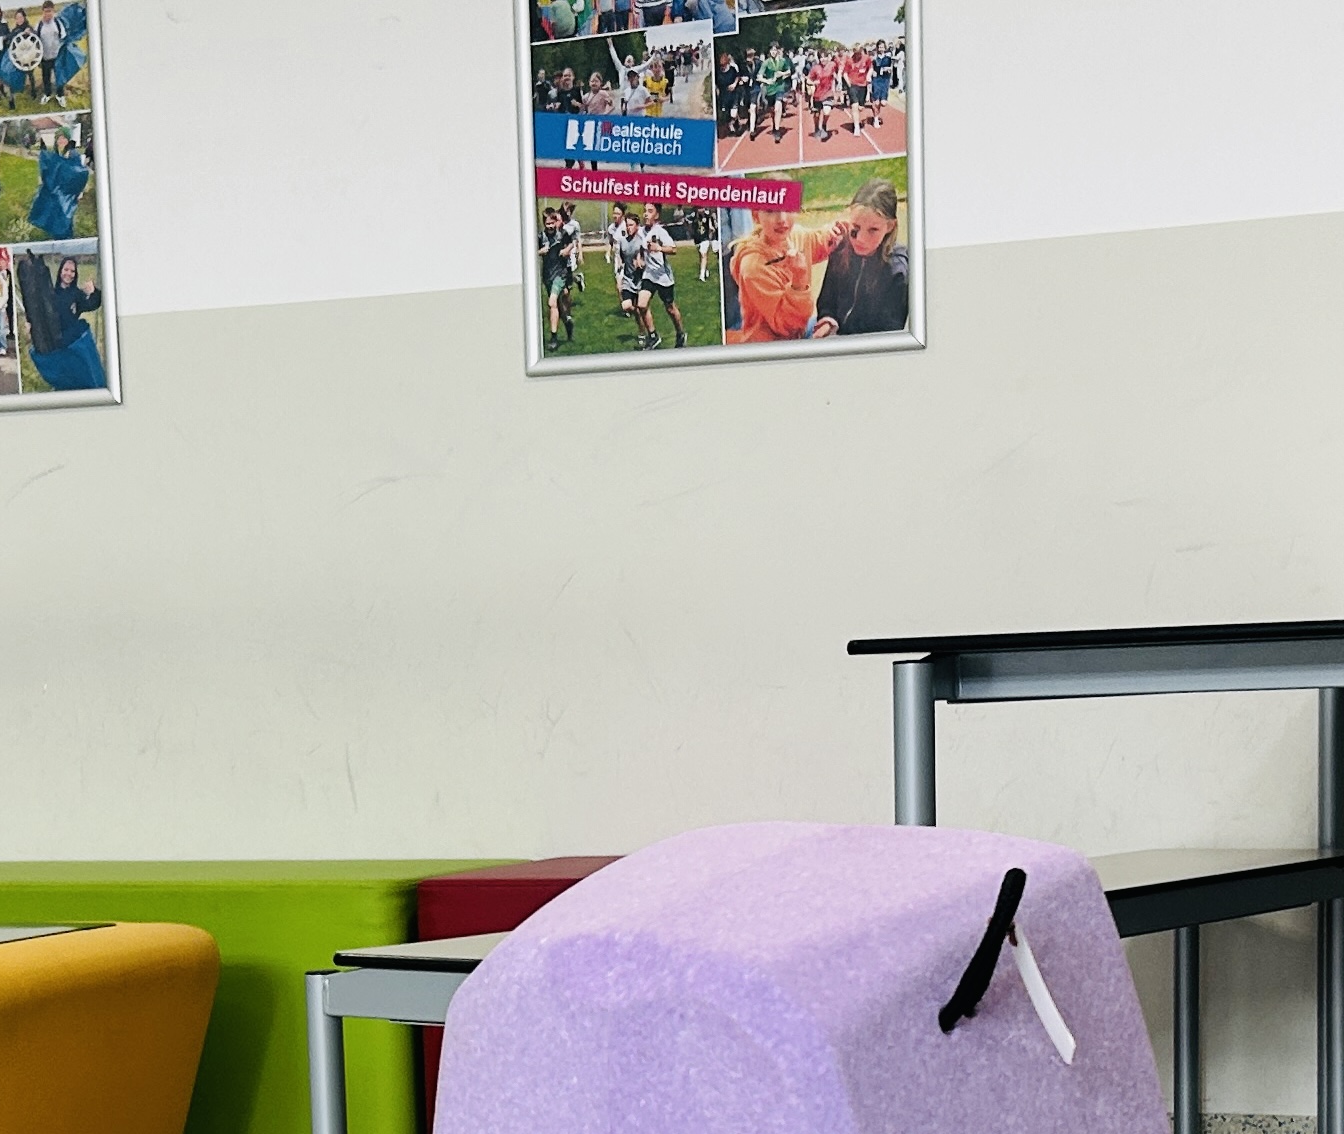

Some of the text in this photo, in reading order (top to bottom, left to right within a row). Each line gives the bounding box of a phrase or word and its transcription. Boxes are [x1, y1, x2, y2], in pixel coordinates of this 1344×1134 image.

[601, 121, 683, 140] Realschule
[601, 136, 682, 155] Dettelbach
[560, 175, 787, 204] Schulfest mit Spendenlauf
